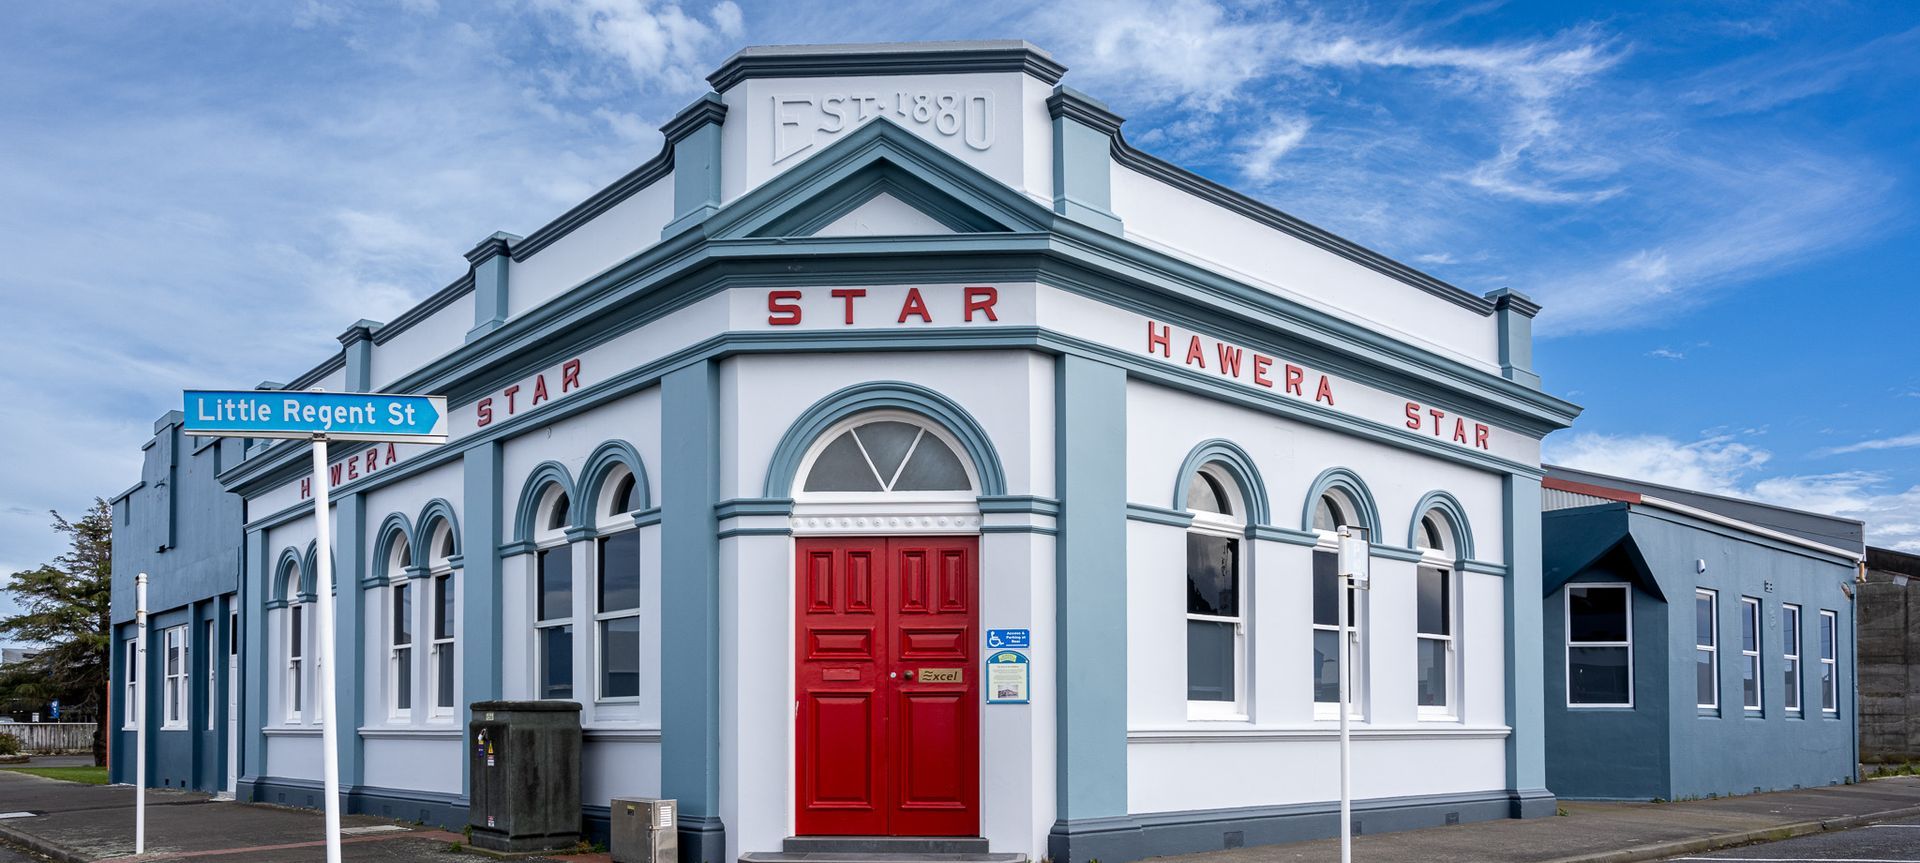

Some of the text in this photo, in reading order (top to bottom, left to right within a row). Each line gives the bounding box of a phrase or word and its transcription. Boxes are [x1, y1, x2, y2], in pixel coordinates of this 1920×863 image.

[896, 89, 996, 151] 1880
[768, 286, 998, 326] STAR
[198, 398, 415, 430] Little Regent St
[1148, 321, 1490, 450] HAWERA STAR
[301, 358, 581, 500] HWERA STAR
